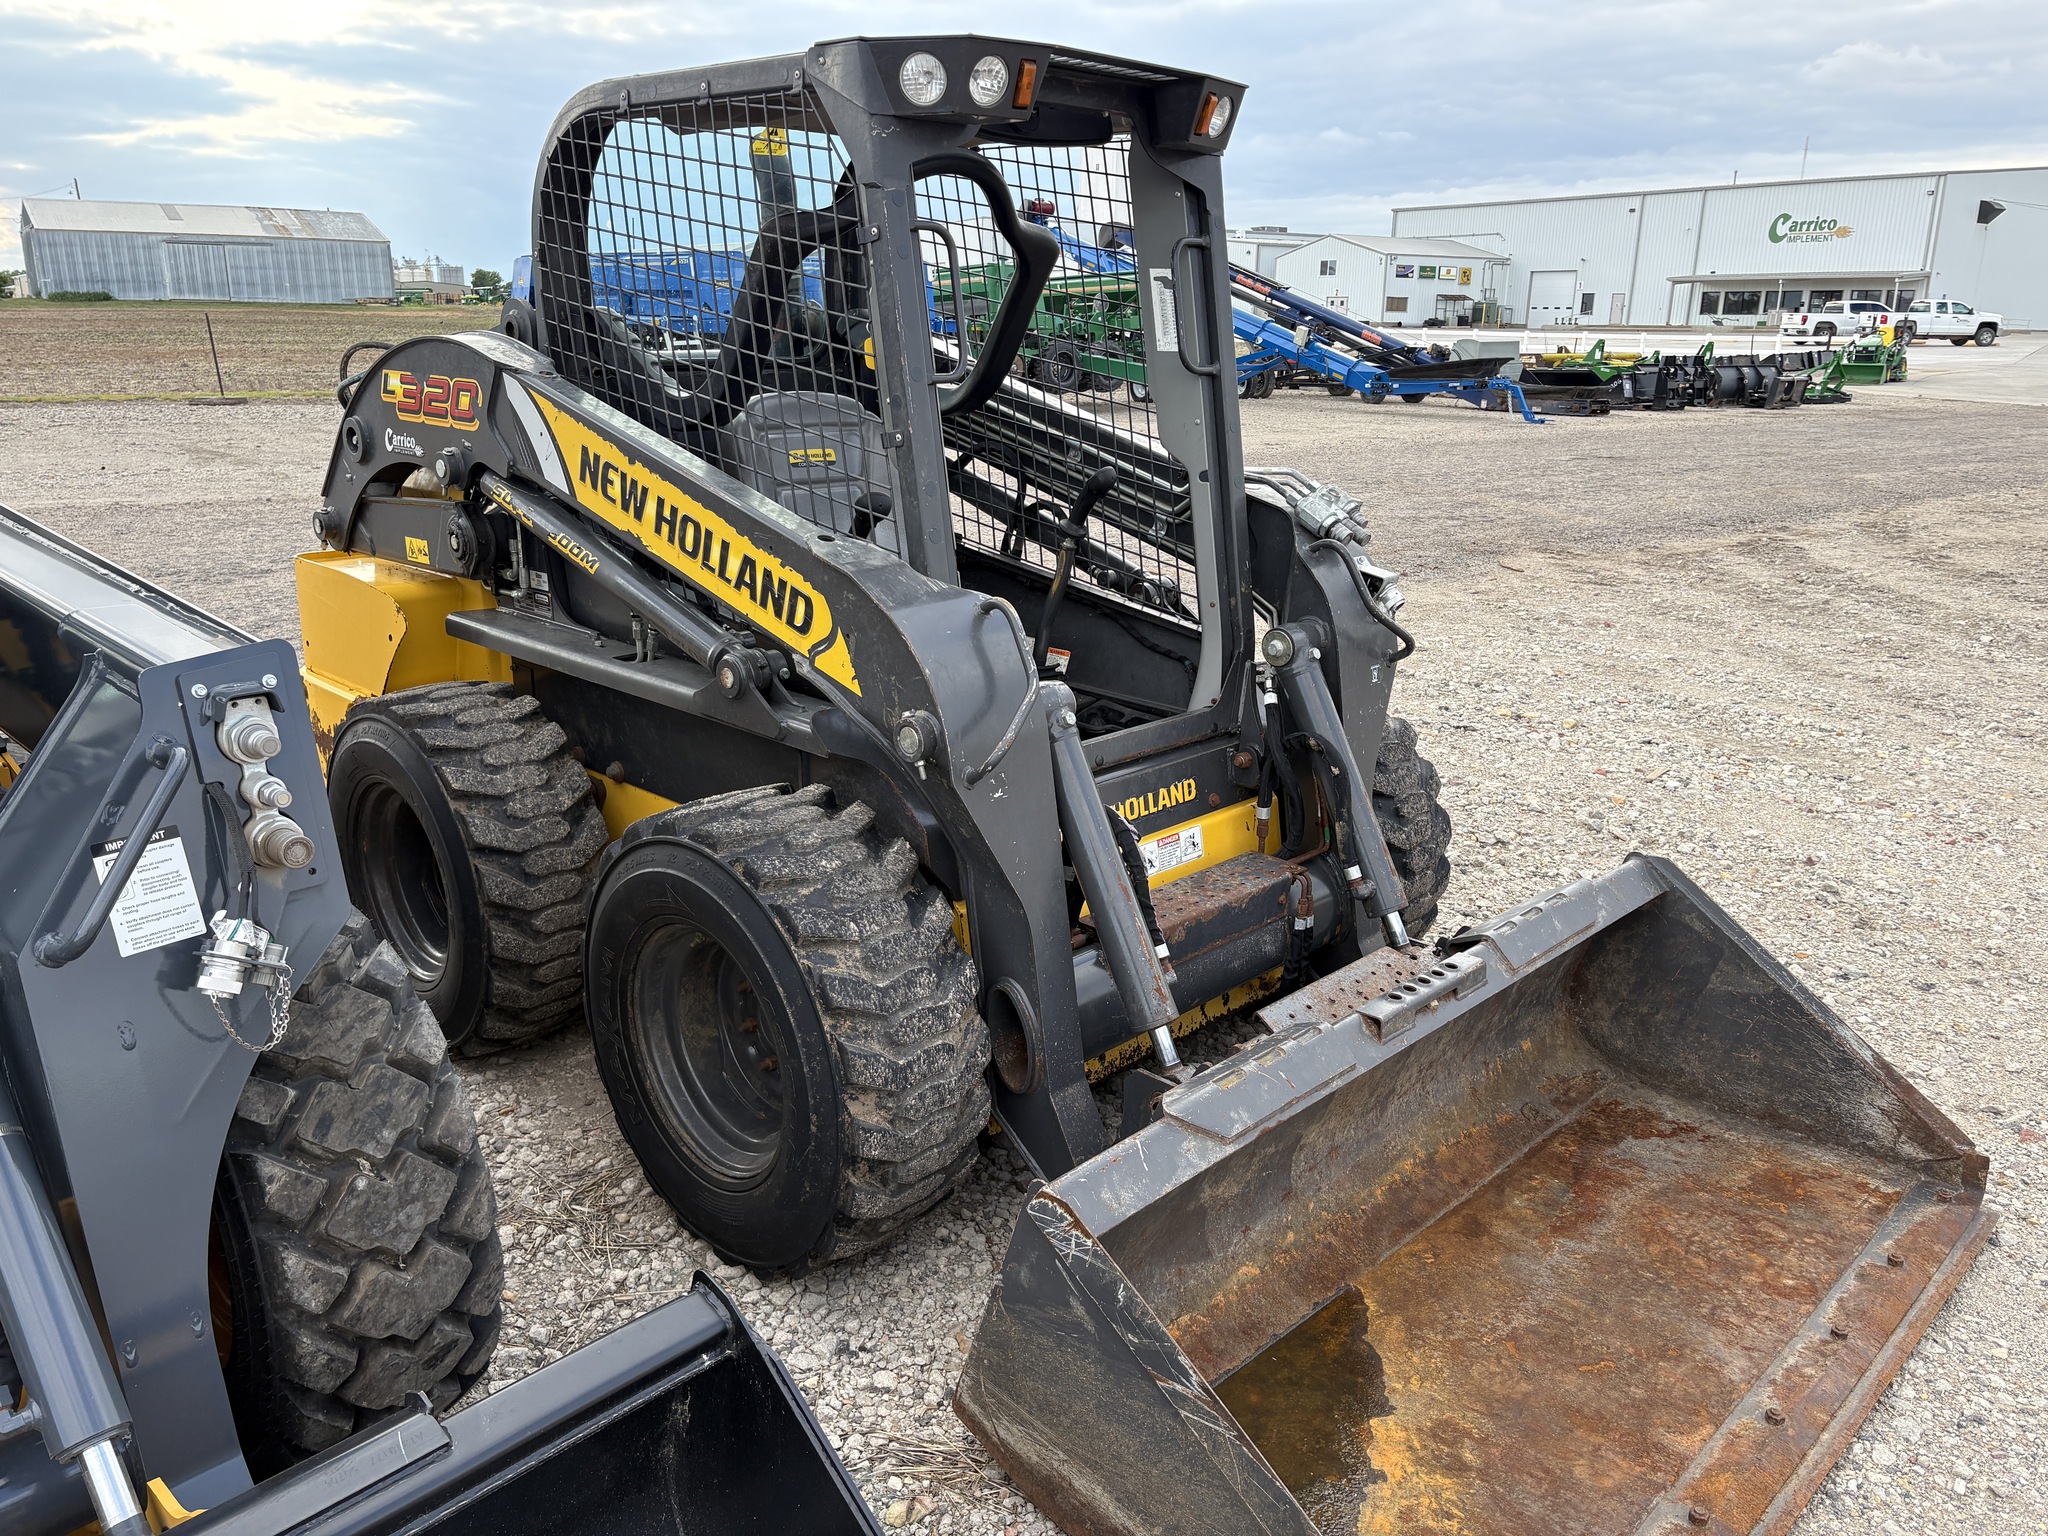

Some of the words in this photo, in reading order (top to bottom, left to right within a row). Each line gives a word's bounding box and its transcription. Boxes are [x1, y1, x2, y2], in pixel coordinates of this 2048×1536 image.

[1768, 213, 1838, 243] Carrico
[1786, 235, 1834, 243] IMPLEMENT
[385, 428, 416, 452] Carrico
[579, 444, 650, 524] NEW
[653, 494, 814, 637] HOLLAND
[1112, 778, 1197, 820] HOLLAND
